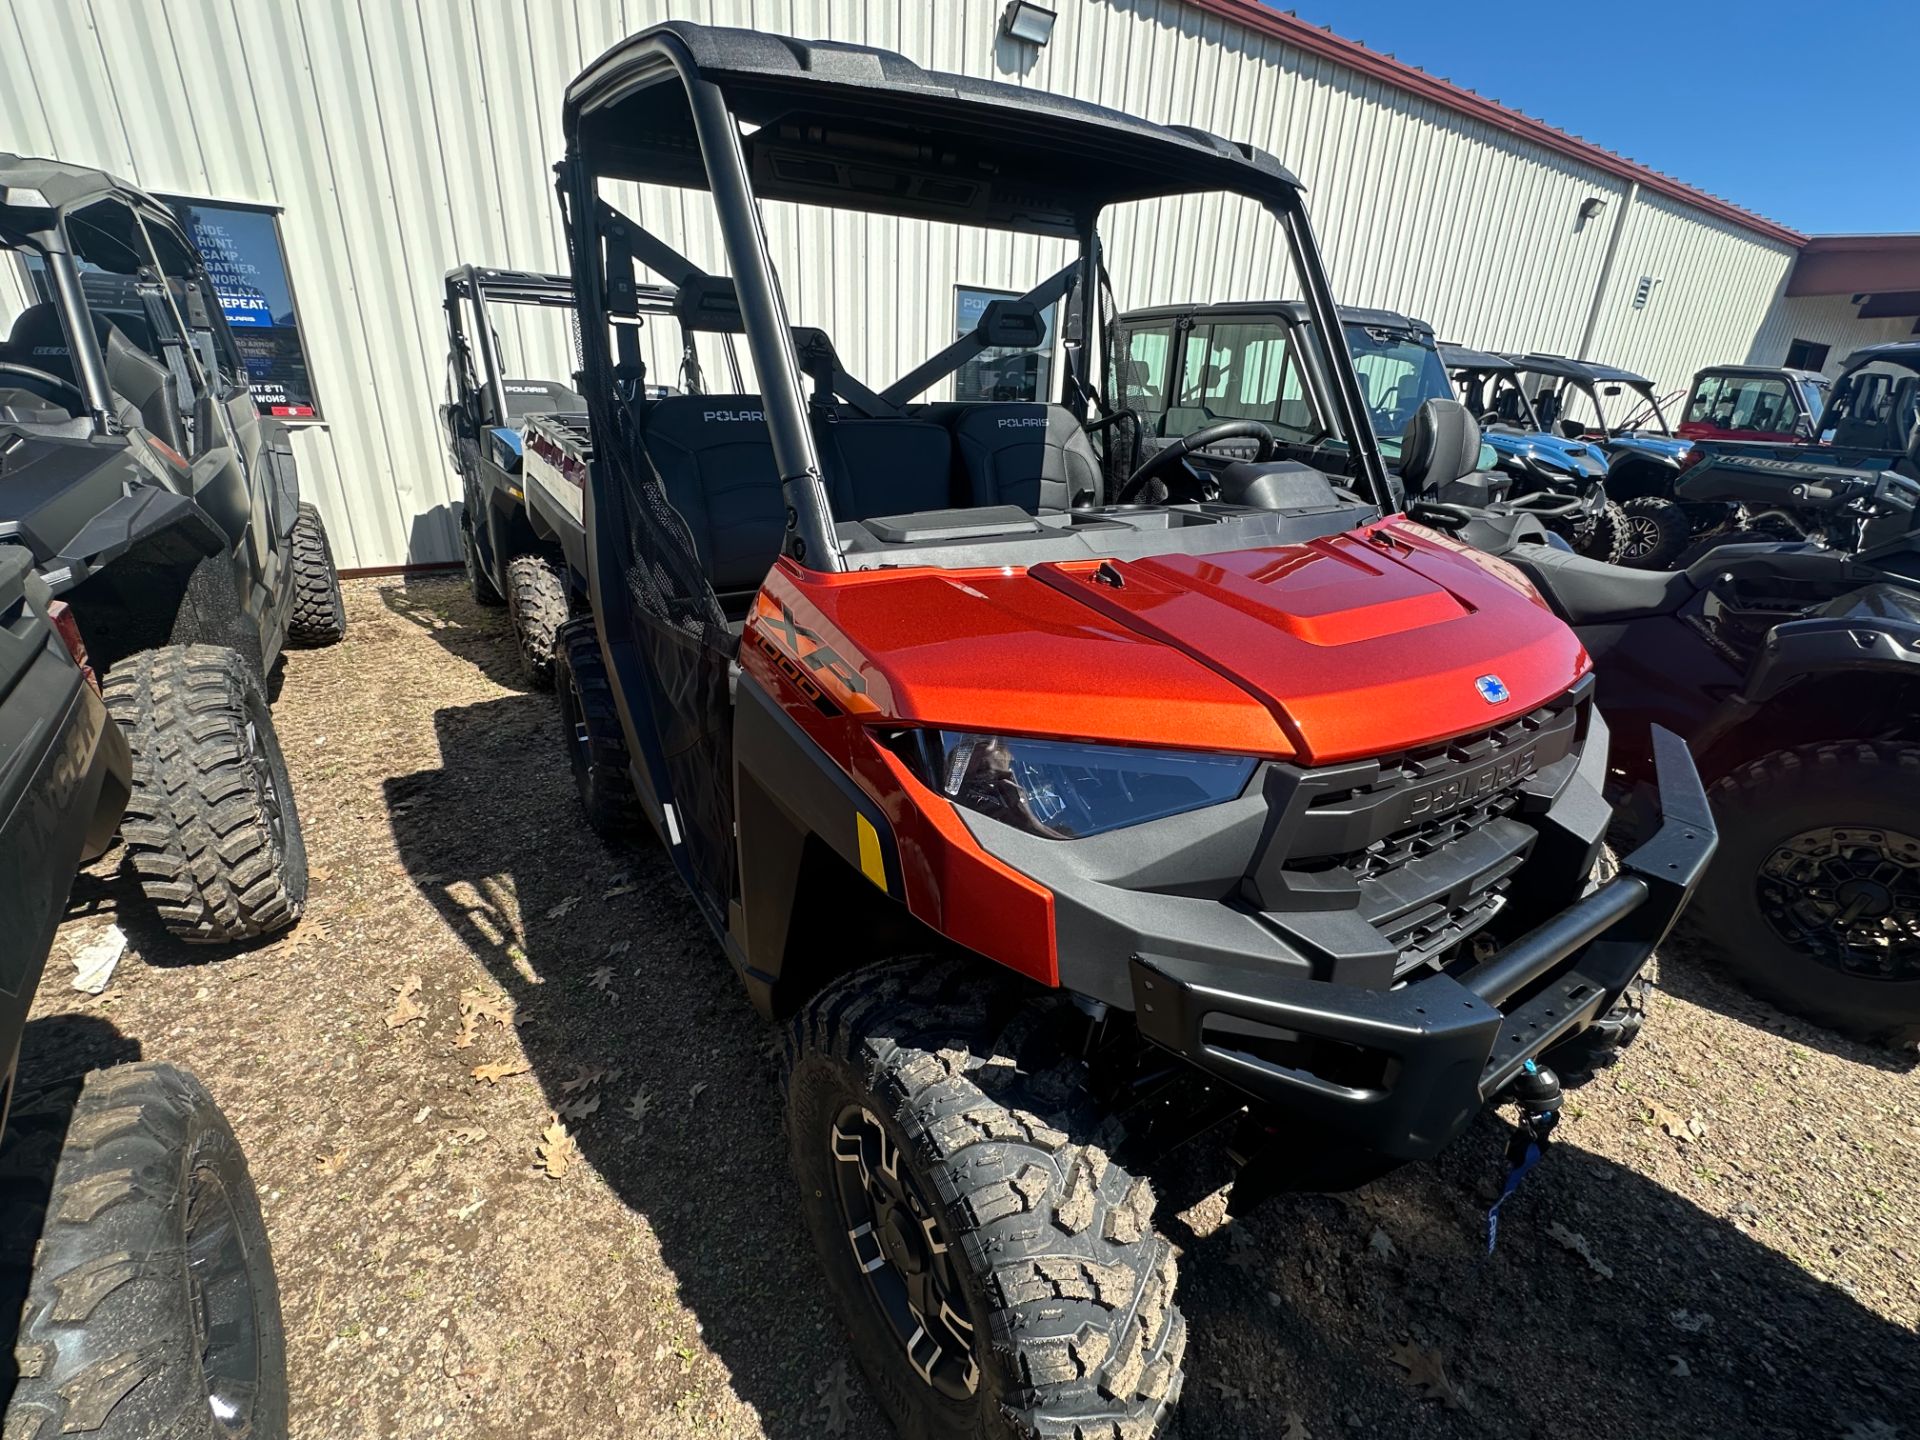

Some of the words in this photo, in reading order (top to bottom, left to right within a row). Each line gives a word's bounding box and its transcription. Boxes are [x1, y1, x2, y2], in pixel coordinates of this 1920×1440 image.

[194, 225, 230, 237] RIDE.
[198, 237, 237, 249] HUNT.
[201, 249, 243, 262] CAMP.
[204, 261, 260, 275] GATHER.
[209, 274, 251, 286] WORK.
[703, 410, 768, 422] POLARI
[997, 418, 1050, 429] POLARIS
[1719, 455, 1818, 473] RANGER
[759, 601, 868, 694] XP
[753, 633, 822, 701] 1000
[1403, 744, 1537, 824] POLARIS
